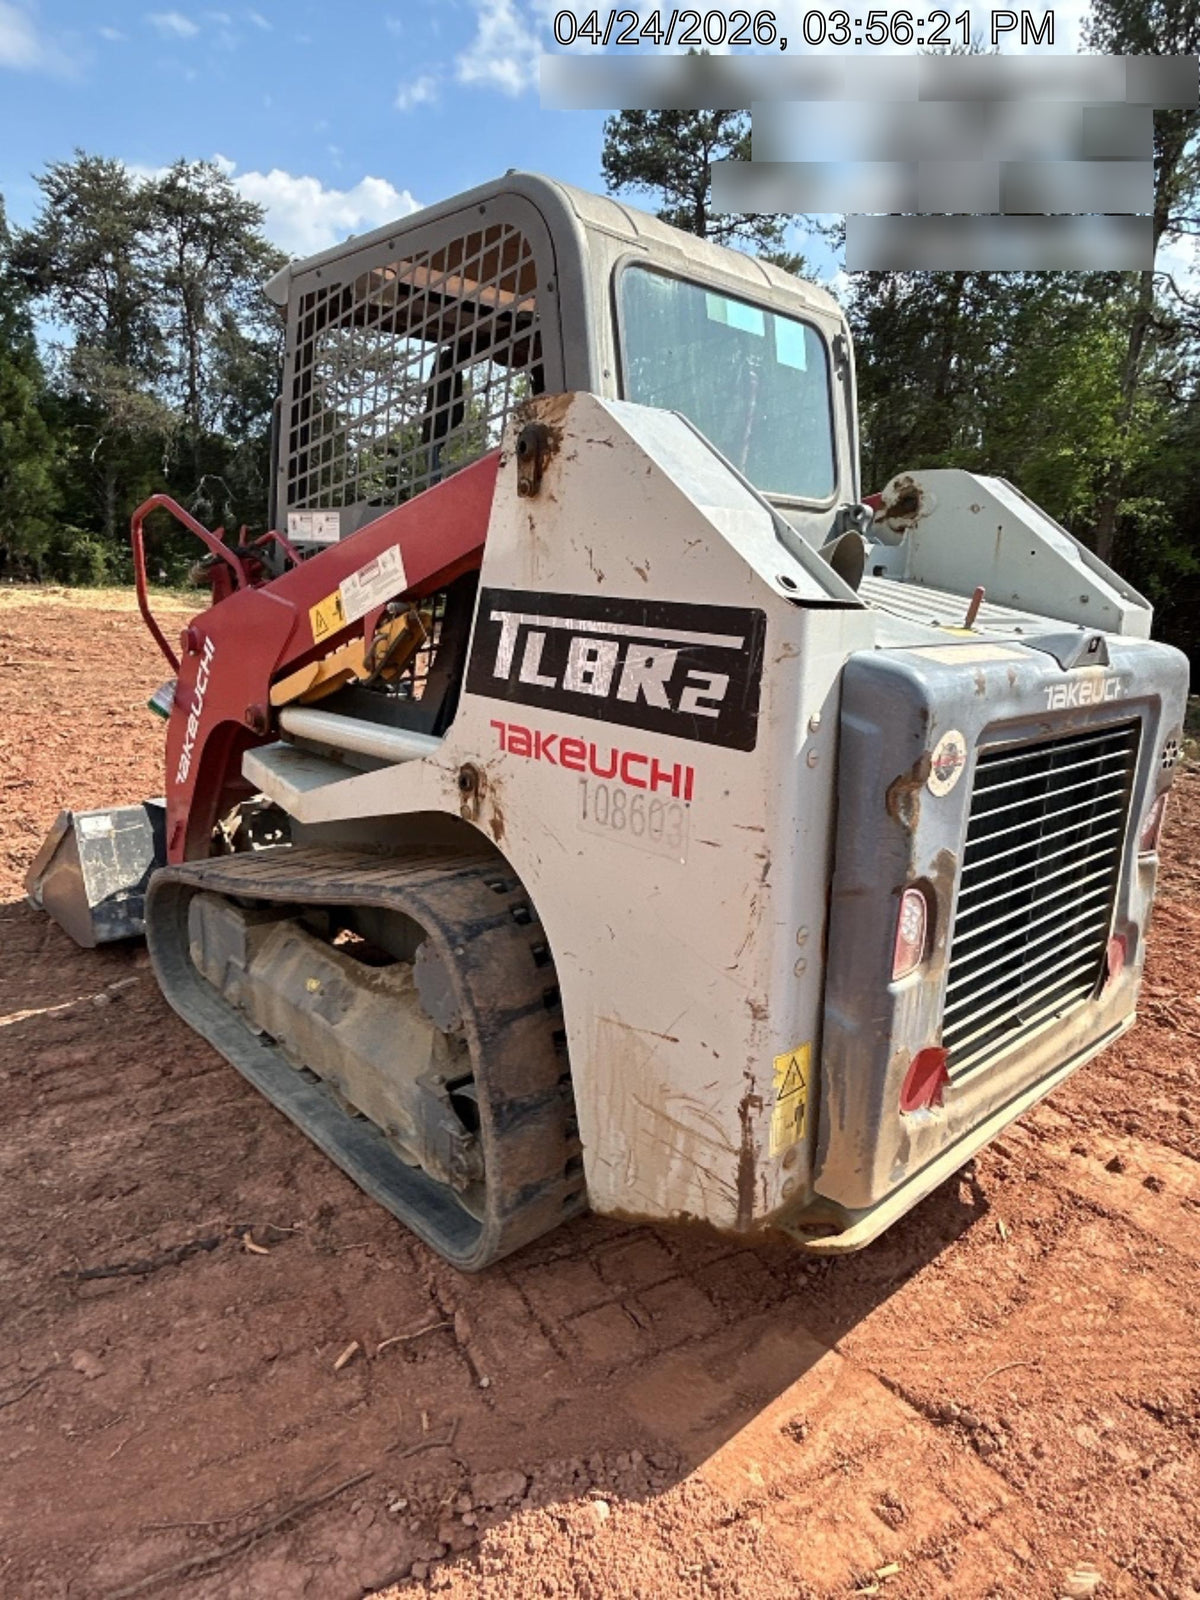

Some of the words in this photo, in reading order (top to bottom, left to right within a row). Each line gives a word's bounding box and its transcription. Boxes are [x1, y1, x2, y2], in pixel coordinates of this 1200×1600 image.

[175, 635, 216, 785] TAKEUCHI
[489, 609, 746, 719] TL8R2
[489, 719, 695, 802] TAKEUCHI
